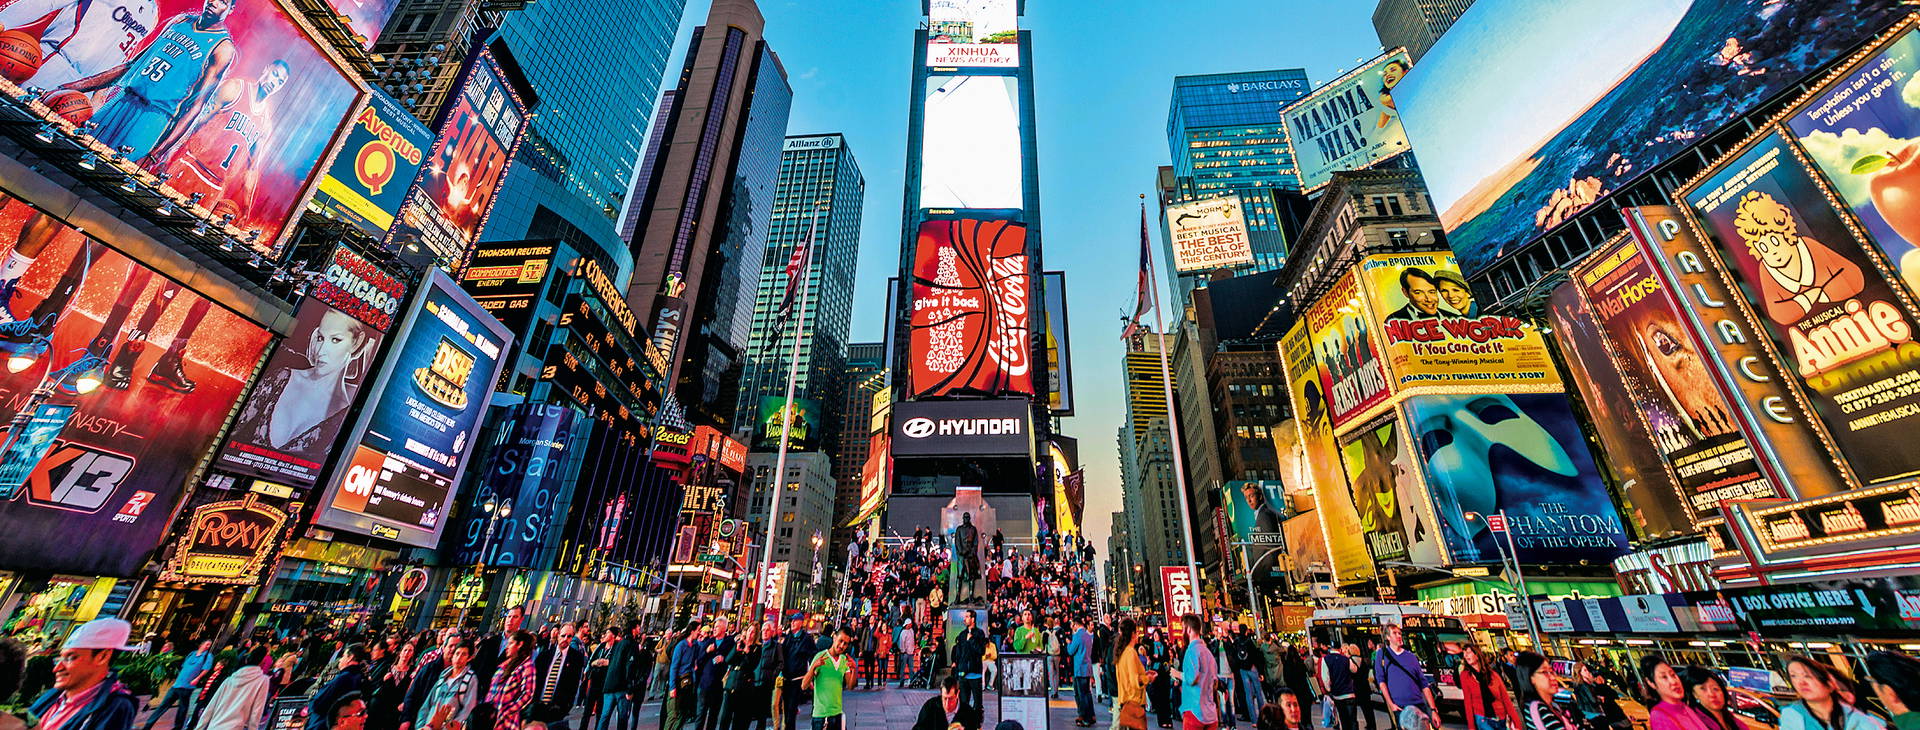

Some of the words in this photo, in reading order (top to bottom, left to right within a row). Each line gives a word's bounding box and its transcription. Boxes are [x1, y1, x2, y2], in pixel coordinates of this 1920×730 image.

[162, 42, 185, 59] CITY
[948, 47, 998, 56] XINHUA
[140, 56, 173, 83] 35
[1242, 80, 1301, 92] BARCLAYS
[1807, 88, 1853, 120] Temptation
[1850, 72, 1872, 90] isn't
[1872, 68, 1880, 76] a
[1823, 104, 1853, 126] Unless
[1852, 92, 1871, 111] you
[1871, 78, 1892, 98] give
[1889, 70, 1906, 81] in.
[1292, 84, 1374, 144] MAMMA
[358, 106, 422, 165] Avenue
[789, 140, 820, 148] Allianz
[1317, 118, 1367, 166] MIA!
[220, 144, 239, 170] 1
[355, 140, 396, 196] Q
[1706, 186, 1724, 202] TONY
[1177, 232, 1198, 240] BEST
[1201, 226, 1241, 236] MUSICAL
[1208, 233, 1242, 246] BEST
[477, 248, 516, 258] THOMSON
[516, 246, 552, 256] REUTERS
[1179, 245, 1227, 258] MUSICAL
[1229, 242, 1245, 251] OF
[1181, 256, 1202, 264] THIS
[1388, 256, 1436, 267] BRODERICK
[470, 267, 518, 278] COMMODITIES
[477, 279, 504, 287] ENERGY
[326, 263, 397, 315] CHICAGO
[586, 259, 626, 321] CONFERENCE
[623, 309, 637, 337] CALL
[1309, 304, 1325, 322] THE
[1325, 273, 1355, 308] CROWD
[509, 300, 528, 308] GAS
[914, 297, 939, 311] give
[941, 296, 951, 307] it
[953, 296, 979, 308] back
[987, 248, 1029, 376] Coca-Cola
[1312, 310, 1335, 334] GOES
[1658, 218, 1795, 424] PALACE
[1798, 321, 1813, 332] THE
[1813, 306, 1844, 325] MUSICAL
[1384, 317, 1446, 346] NICE
[1441, 315, 1525, 343] WORK
[1789, 299, 1912, 379] Annie
[1413, 344, 1424, 355] If
[1425, 344, 1446, 355] You
[1447, 342, 1469, 353] Can
[1470, 343, 1493, 354] Get
[1493, 343, 1504, 353] It
[432, 342, 474, 388] DISH
[1452, 372, 1492, 381] FUNNIEST
[1494, 371, 1517, 379] LOVE
[1518, 371, 1545, 379] STORY
[1332, 371, 1363, 418] JERSEY
[1358, 356, 1386, 401] BOYS
[1841, 403, 1855, 414] OR
[939, 418, 1020, 436] HYUNDAI
[520, 437, 544, 447] Morgan
[544, 439, 565, 451] Stanley
[344, 465, 378, 497] CNN
[1691, 490, 1719, 507] LINCOLN
[1717, 484, 1745, 500] CENTER
[112, 513, 138, 523] SPORTS
[1539, 502, 1568, 513] THE
[1821, 501, 1867, 535] Annie
[1507, 514, 1621, 535] PHANTOM
[1769, 510, 1810, 542] Annie
[1518, 536, 1535, 549] OF
[1540, 536, 1568, 548] THE
[1570, 536, 1617, 548] OPERA
[190, 559, 244, 571] DELICATESSEN
[1170, 570, 1191, 617] tkts
[1449, 591, 1475, 615] sbarro
[1741, 594, 1771, 611] BOX
[1770, 592, 1815, 609] OFFICE
[1813, 590, 1854, 607] HERE
[271, 604, 293, 612] BLUE
[294, 605, 308, 613] FIN
[1697, 592, 1736, 624] Annie
[1436, 618, 1446, 628] ST
